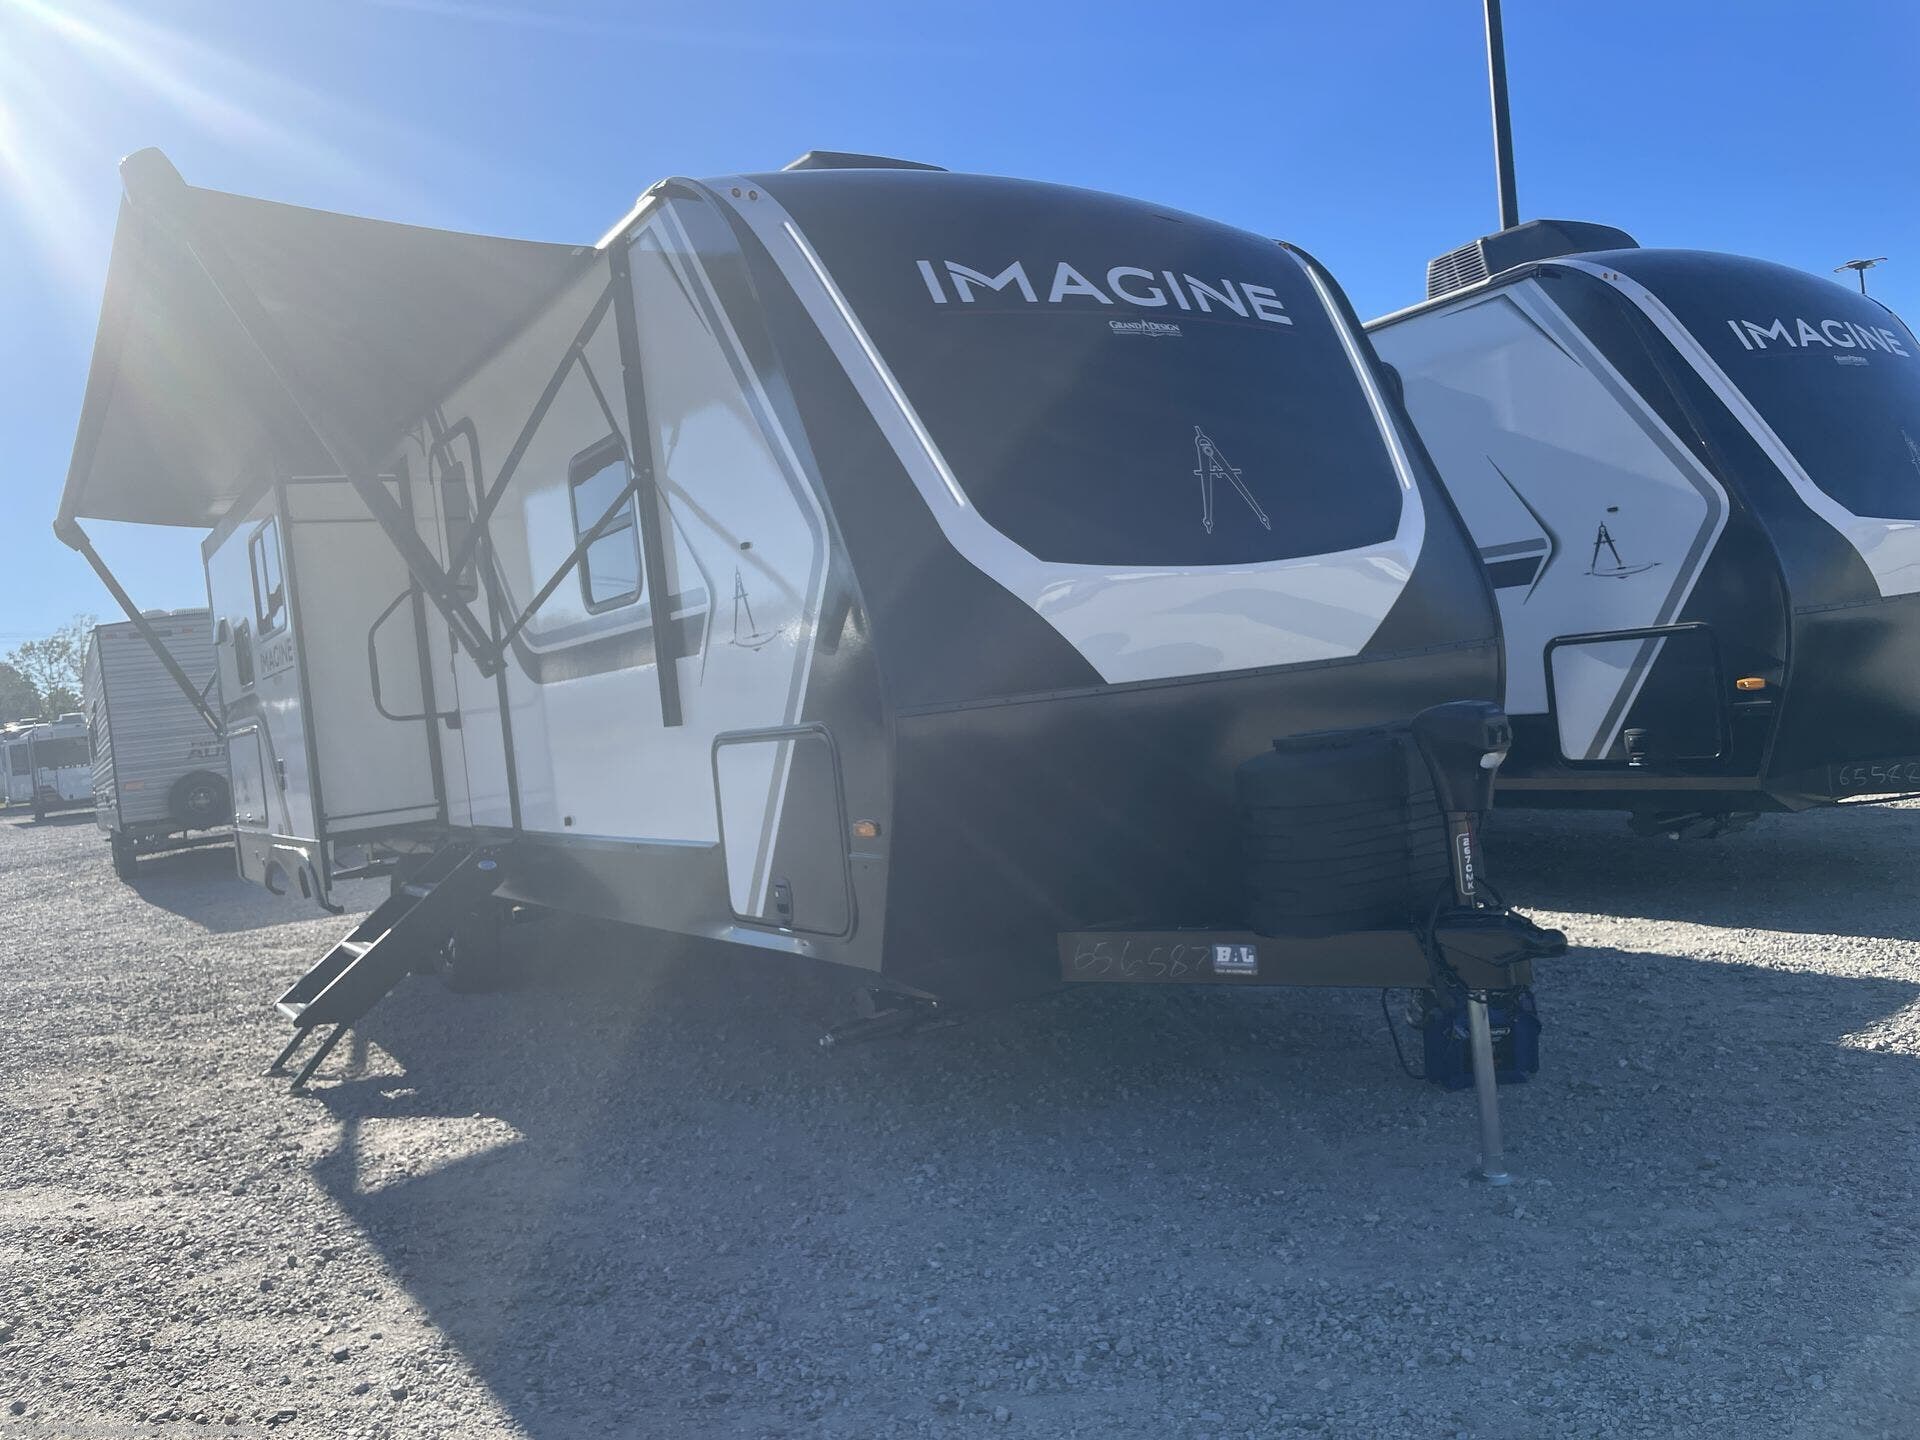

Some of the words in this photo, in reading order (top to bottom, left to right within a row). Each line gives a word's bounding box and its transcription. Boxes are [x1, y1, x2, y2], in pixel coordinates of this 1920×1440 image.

[916, 260, 1293, 326] IMAGINE
[1108, 319, 1142, 330] GRAND
[1148, 321, 1180, 332] DESIGN
[1727, 318, 1911, 358] IMAGINE
